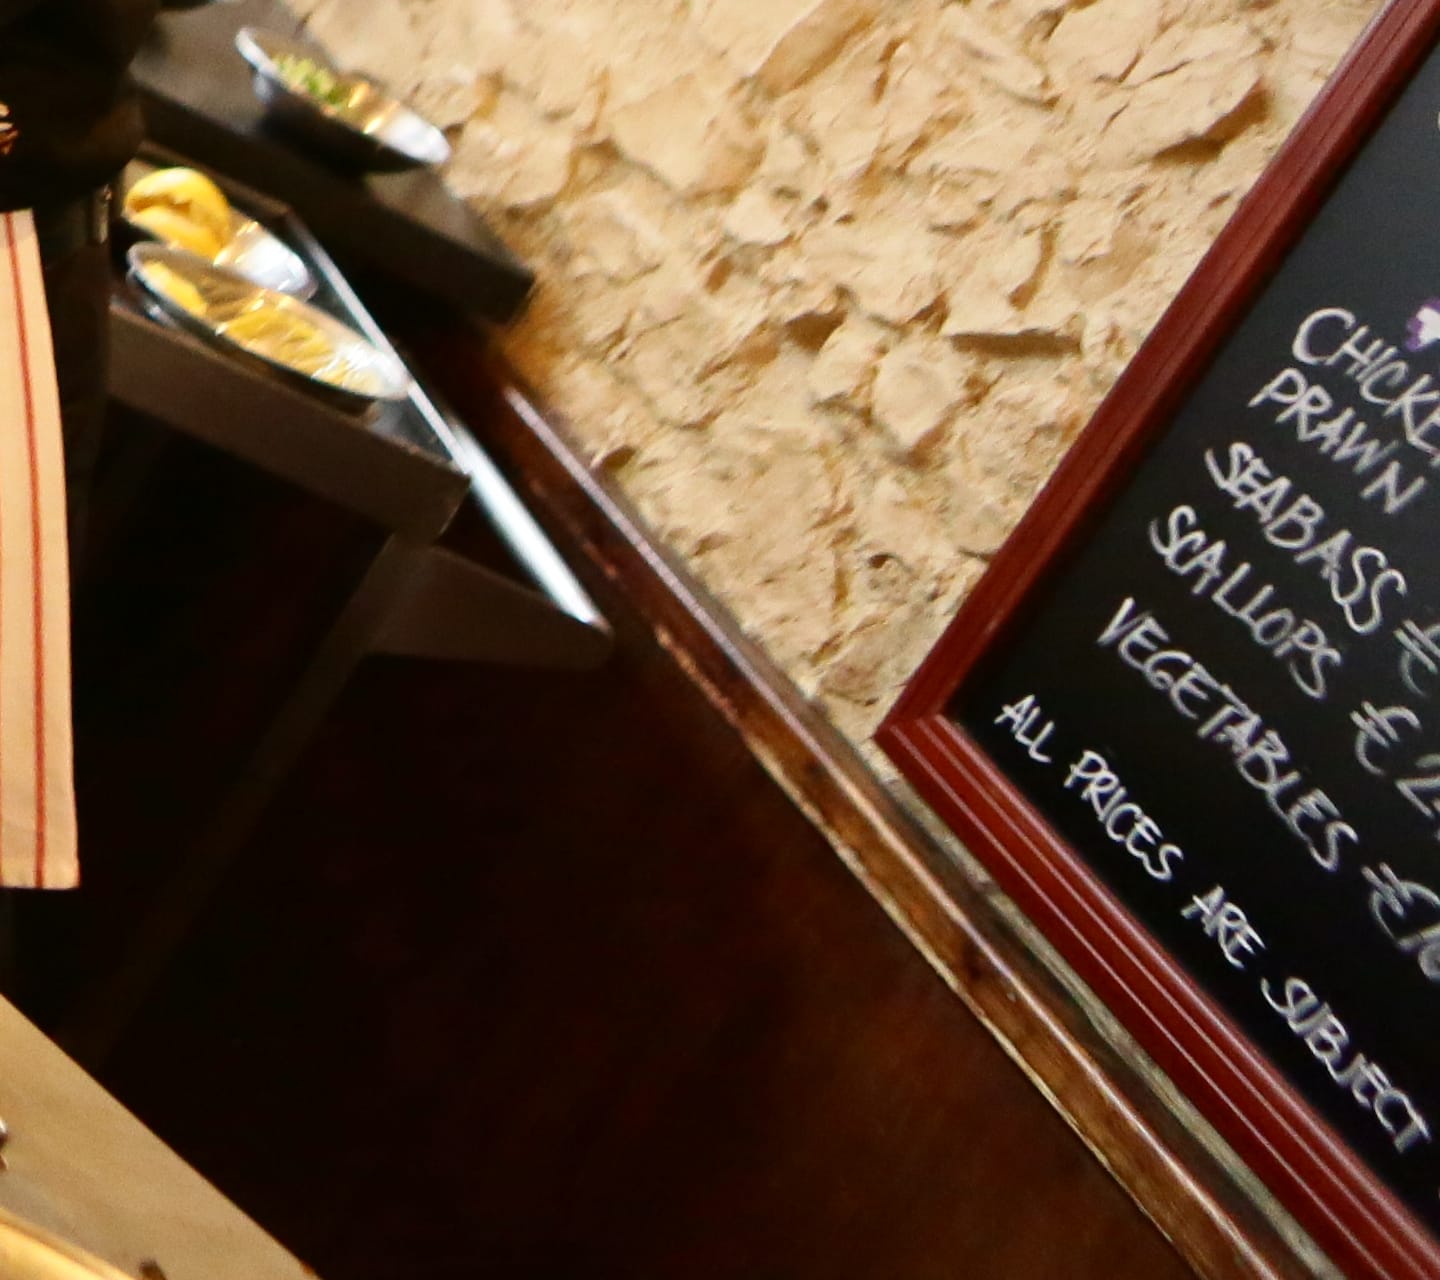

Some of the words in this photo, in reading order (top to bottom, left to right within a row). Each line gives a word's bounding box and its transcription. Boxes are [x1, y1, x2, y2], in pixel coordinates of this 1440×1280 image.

[1247, 367, 1427, 516] PRAWN
[1292, 306, 1440, 470] CHICKE
[1147, 504, 1342, 700] SCALLOPS
[1204, 441, 1409, 636] SEABASS
[1096, 596, 1360, 872] VEGETABLES
[994, 694, 1057, 764] ALL
[1063, 749, 1184, 882] PRICES
[1181, 884, 1267, 970] ARE
[1259, 976, 1433, 1154] SUBJECT
